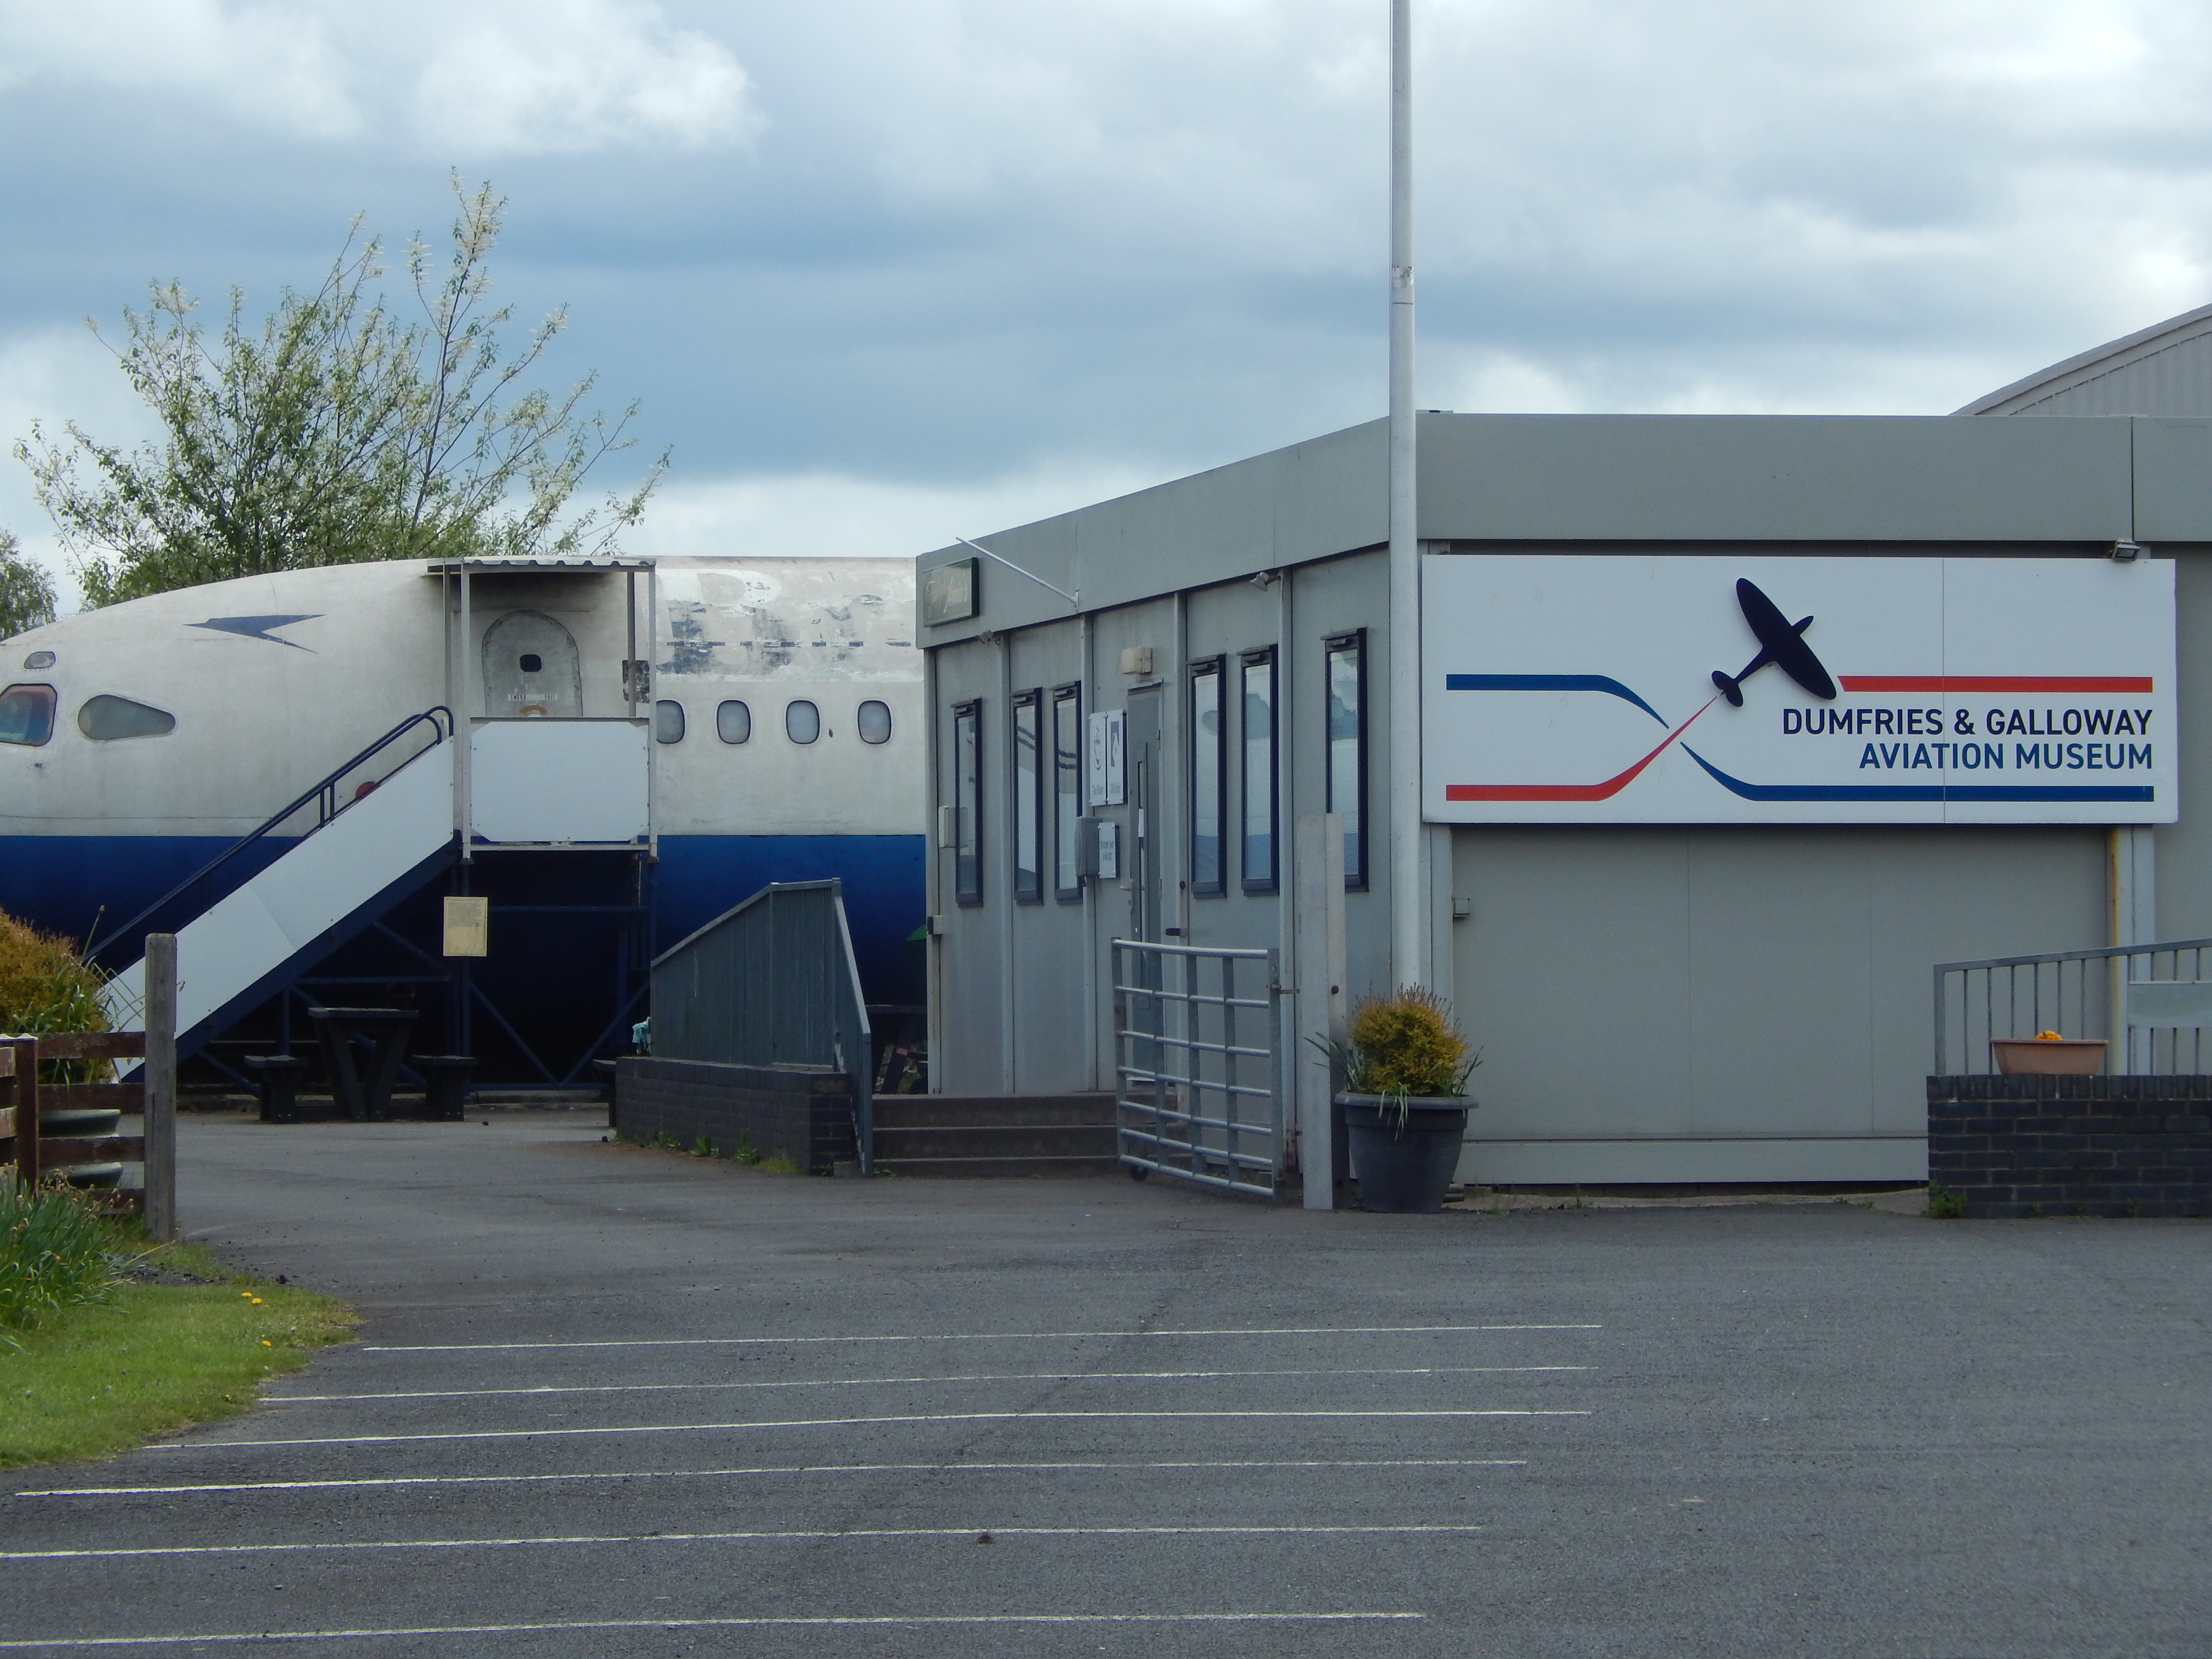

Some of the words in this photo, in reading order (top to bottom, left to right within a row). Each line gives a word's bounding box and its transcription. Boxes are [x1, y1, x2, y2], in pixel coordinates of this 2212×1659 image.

[1783, 708, 1944, 735] DUMFRIES
[1954, 708, 1976, 735] &
[1986, 708, 2153, 735] GALLOWAY
[1859, 743, 2004, 769] AVIATION
[2016, 743, 2152, 769] MUSEUM
